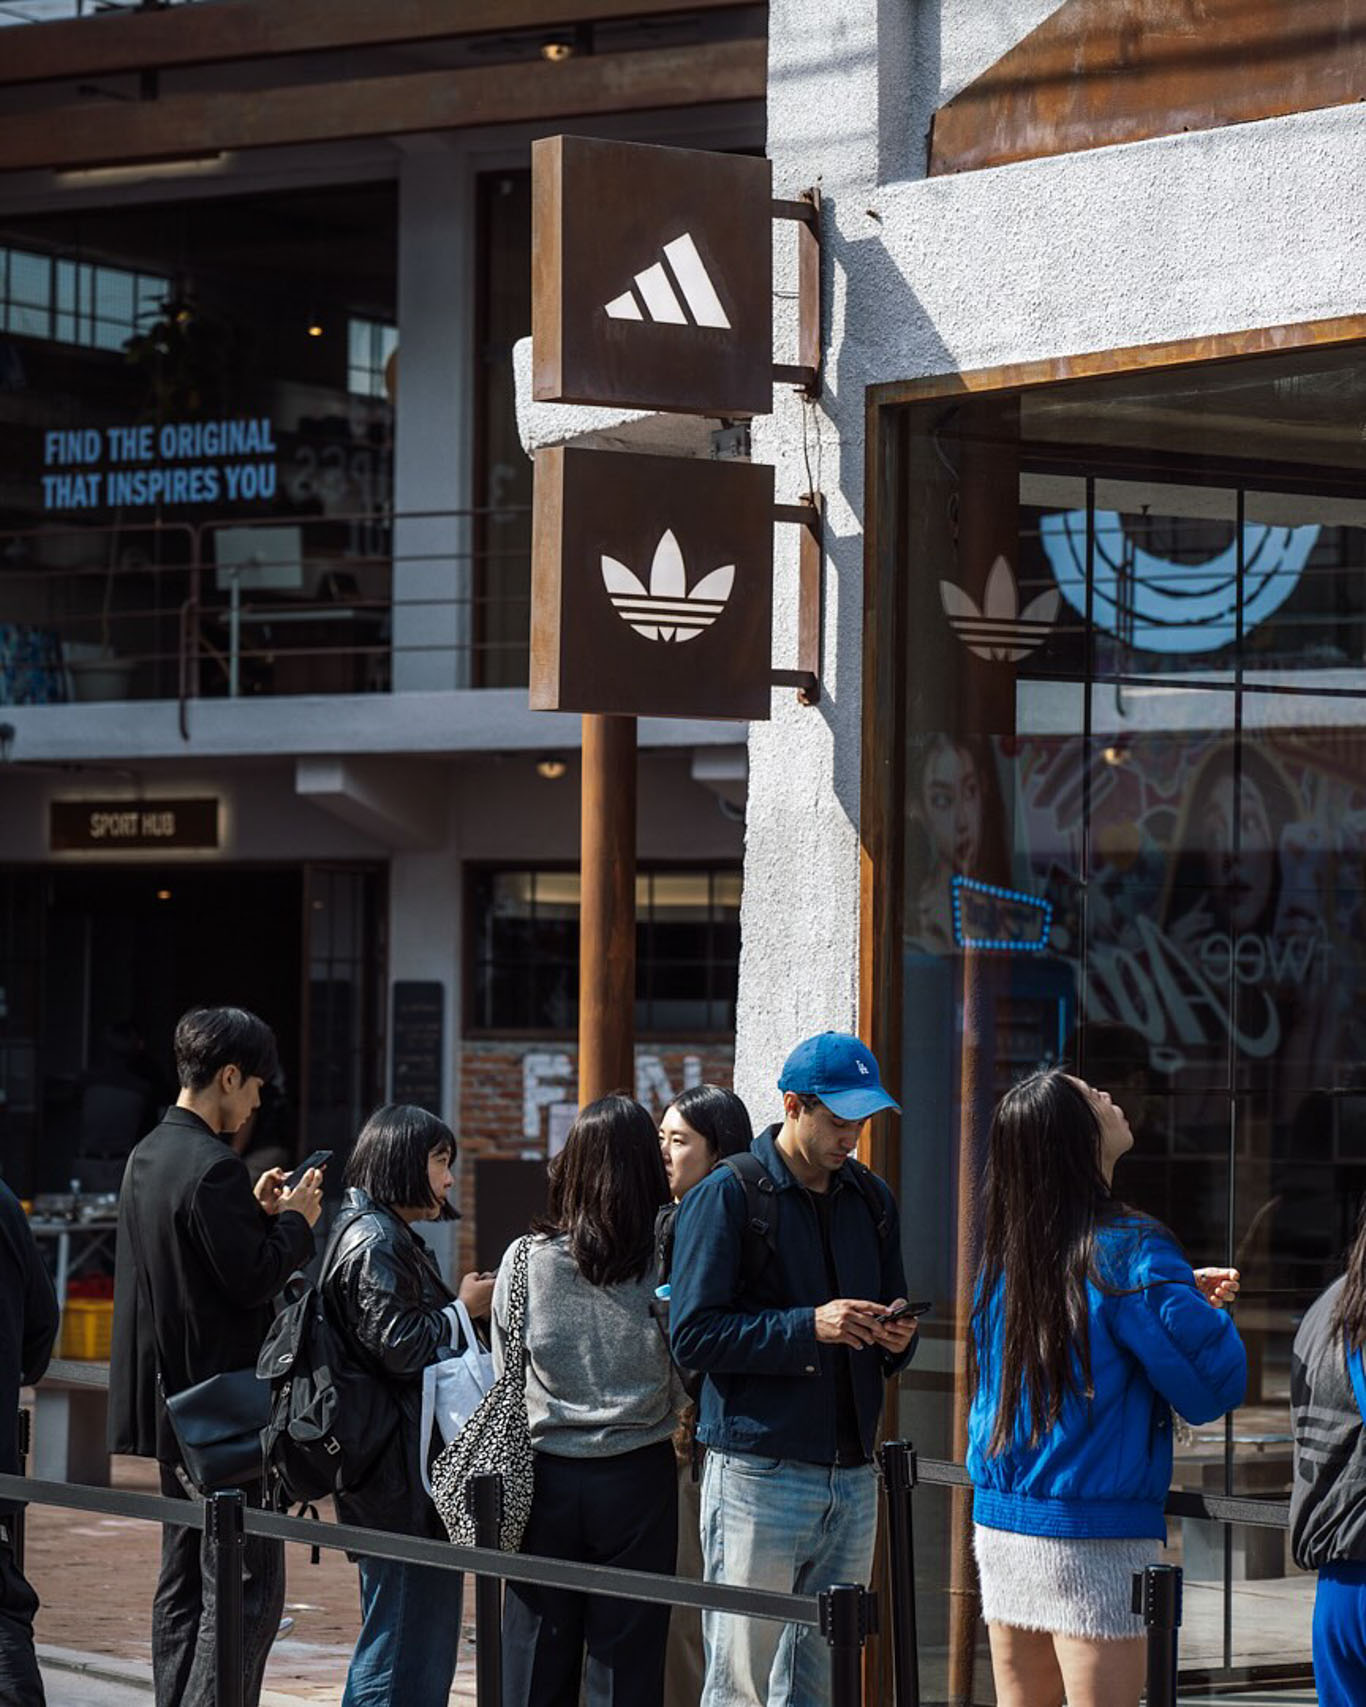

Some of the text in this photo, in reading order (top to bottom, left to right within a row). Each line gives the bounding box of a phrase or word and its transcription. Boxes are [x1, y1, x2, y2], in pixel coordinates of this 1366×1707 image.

[45, 418, 276, 465] FIND THE ORIGINAL
[42, 472, 102, 509] THAT
[107, 466, 220, 507] INSPIRES
[225, 463, 276, 500] YOU
[90, 812, 176, 838] SPORT HUB
